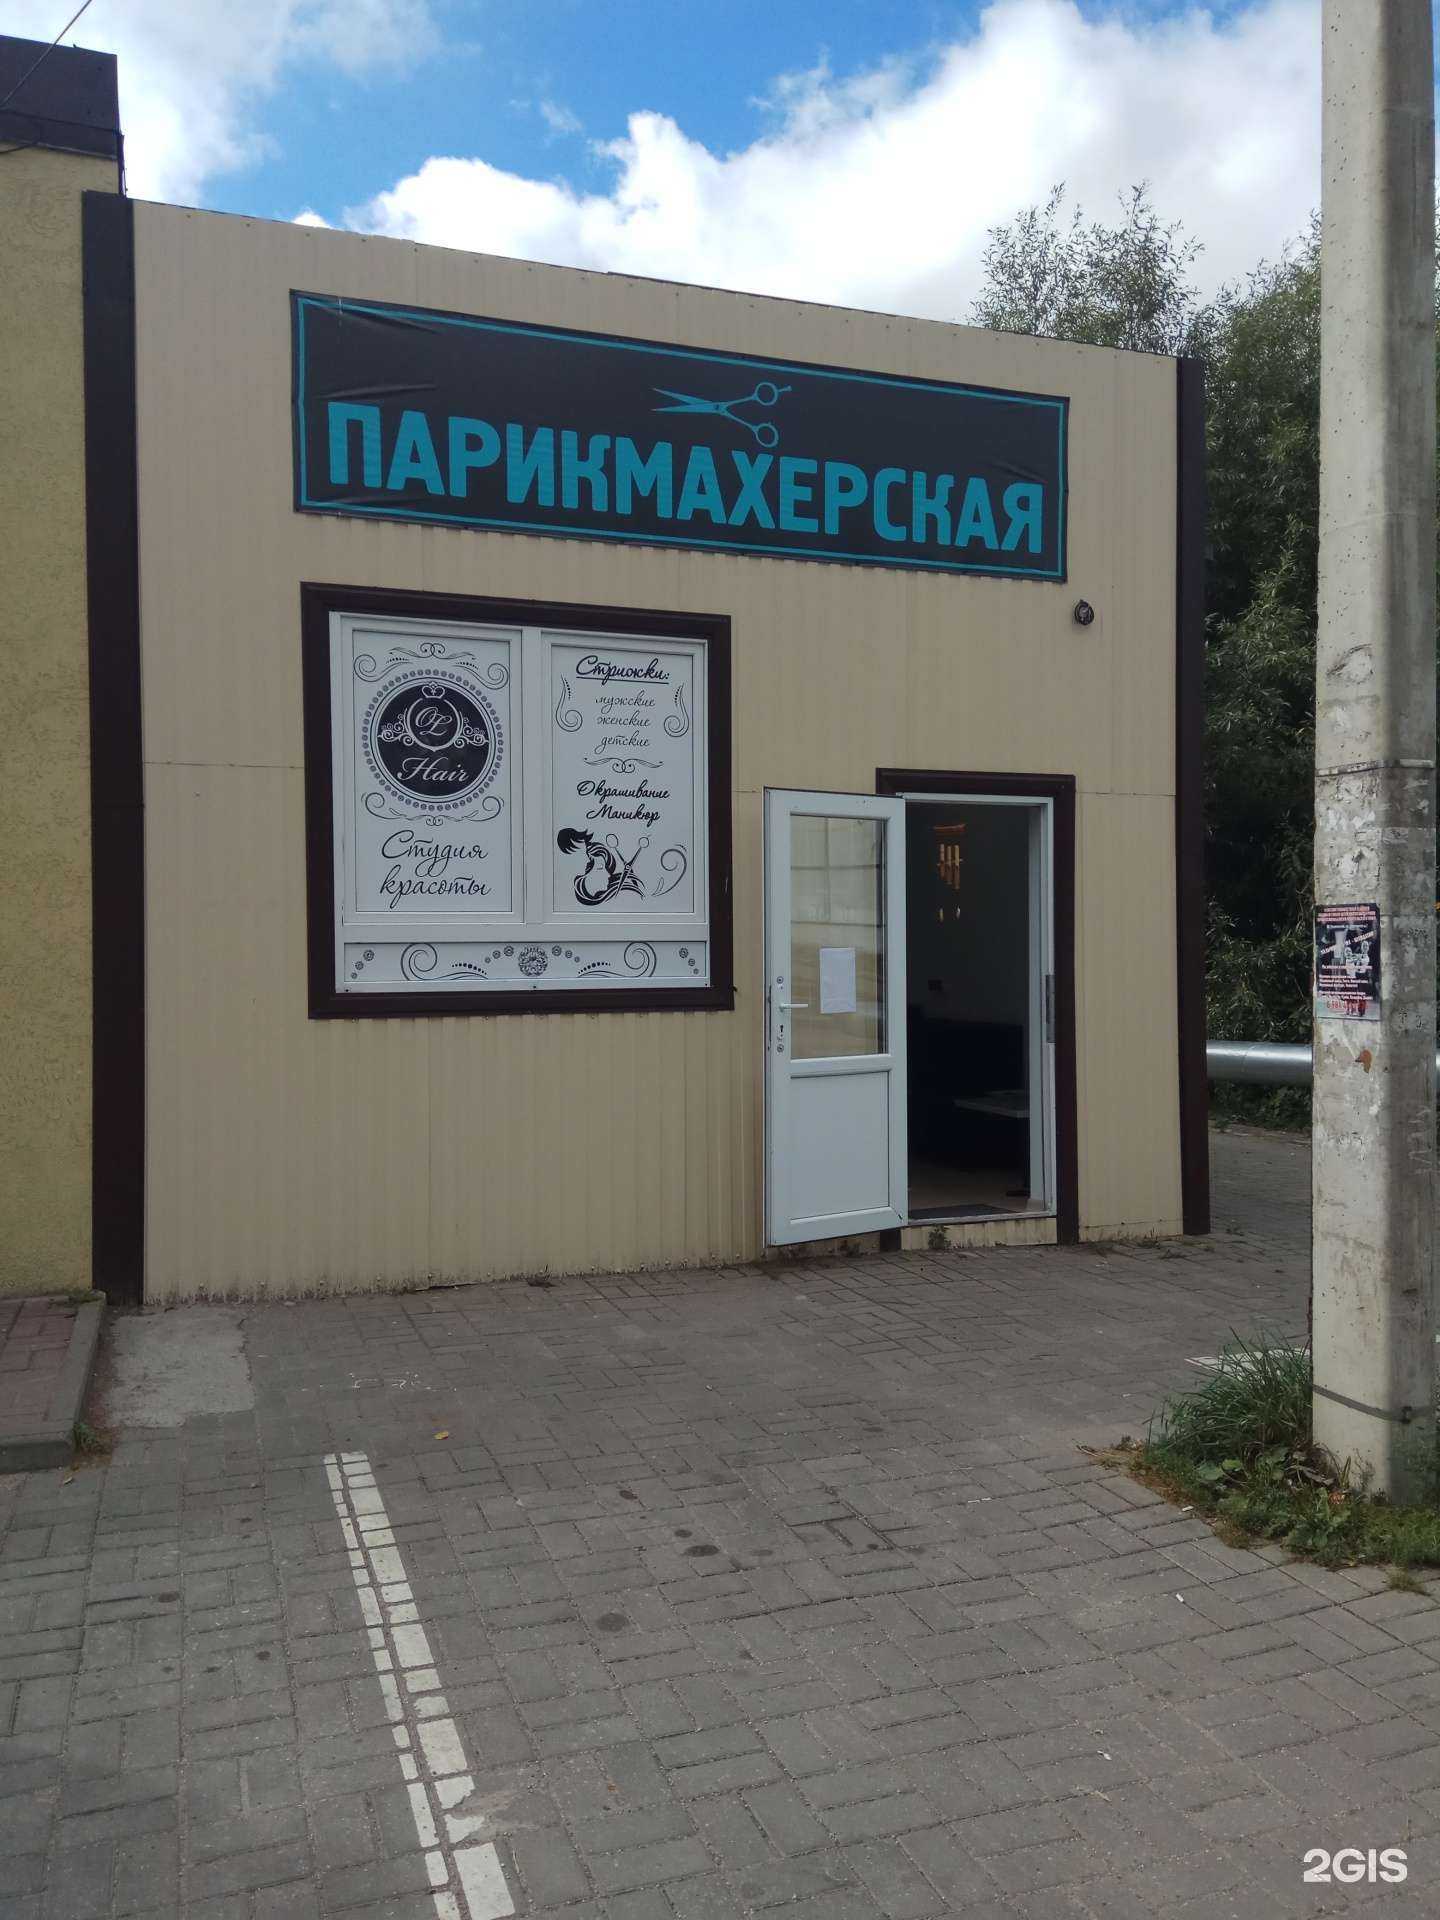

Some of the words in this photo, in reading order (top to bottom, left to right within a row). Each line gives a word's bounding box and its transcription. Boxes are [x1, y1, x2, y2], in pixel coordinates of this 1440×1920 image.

[327, 401, 1044, 554] ПАРИКМАХЕРСКАЯ
[576, 655, 670, 685] Стрижки:
[595, 690, 656, 714] мужские
[596, 710, 651, 727] женские
[594, 730, 650, 754] детские
[397, 756, 469, 782] Hair
[576, 779, 670, 803] Окрашивание
[586, 803, 660, 827] Маникюр
[381, 829, 488, 877] Студия
[380, 864, 492, 909] красоты
